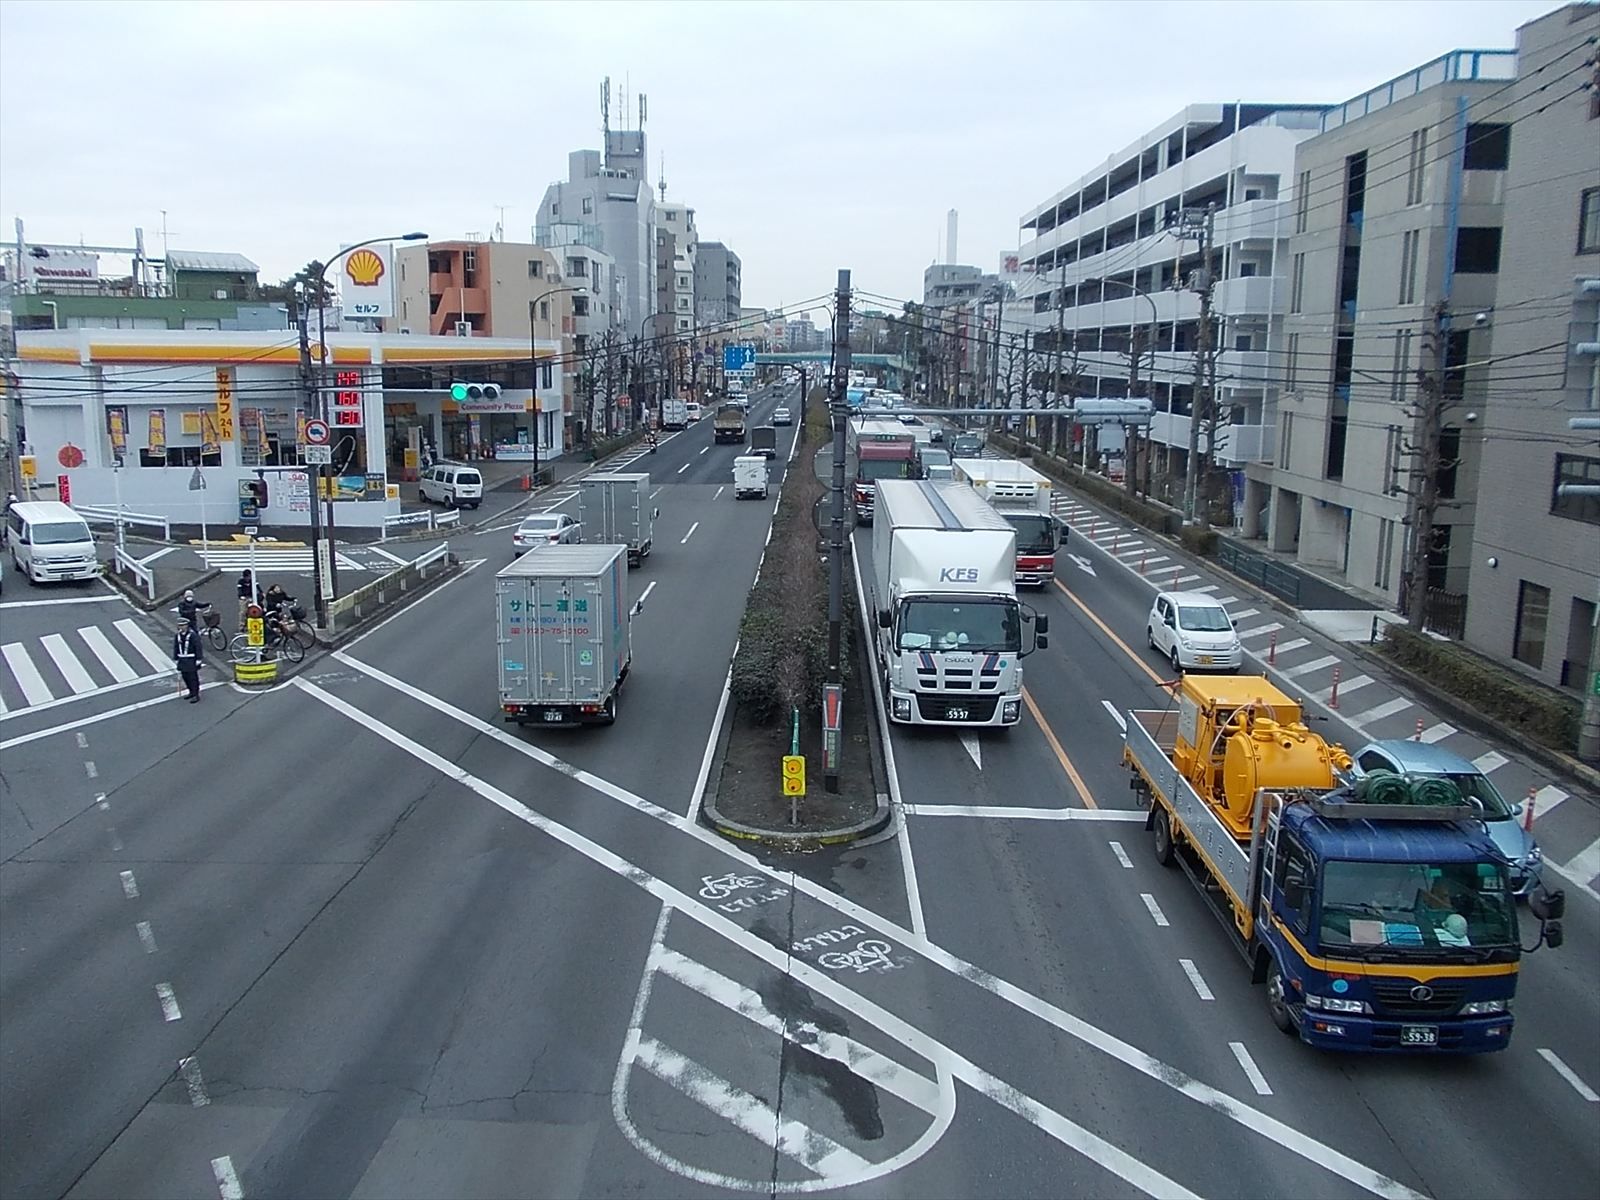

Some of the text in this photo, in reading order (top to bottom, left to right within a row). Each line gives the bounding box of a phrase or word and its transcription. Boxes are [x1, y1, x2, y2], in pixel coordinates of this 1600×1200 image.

[355, 304, 380, 313] セルフ
[461, 402, 524, 411] Community Plaza
[940, 568, 979, 583] KFS
